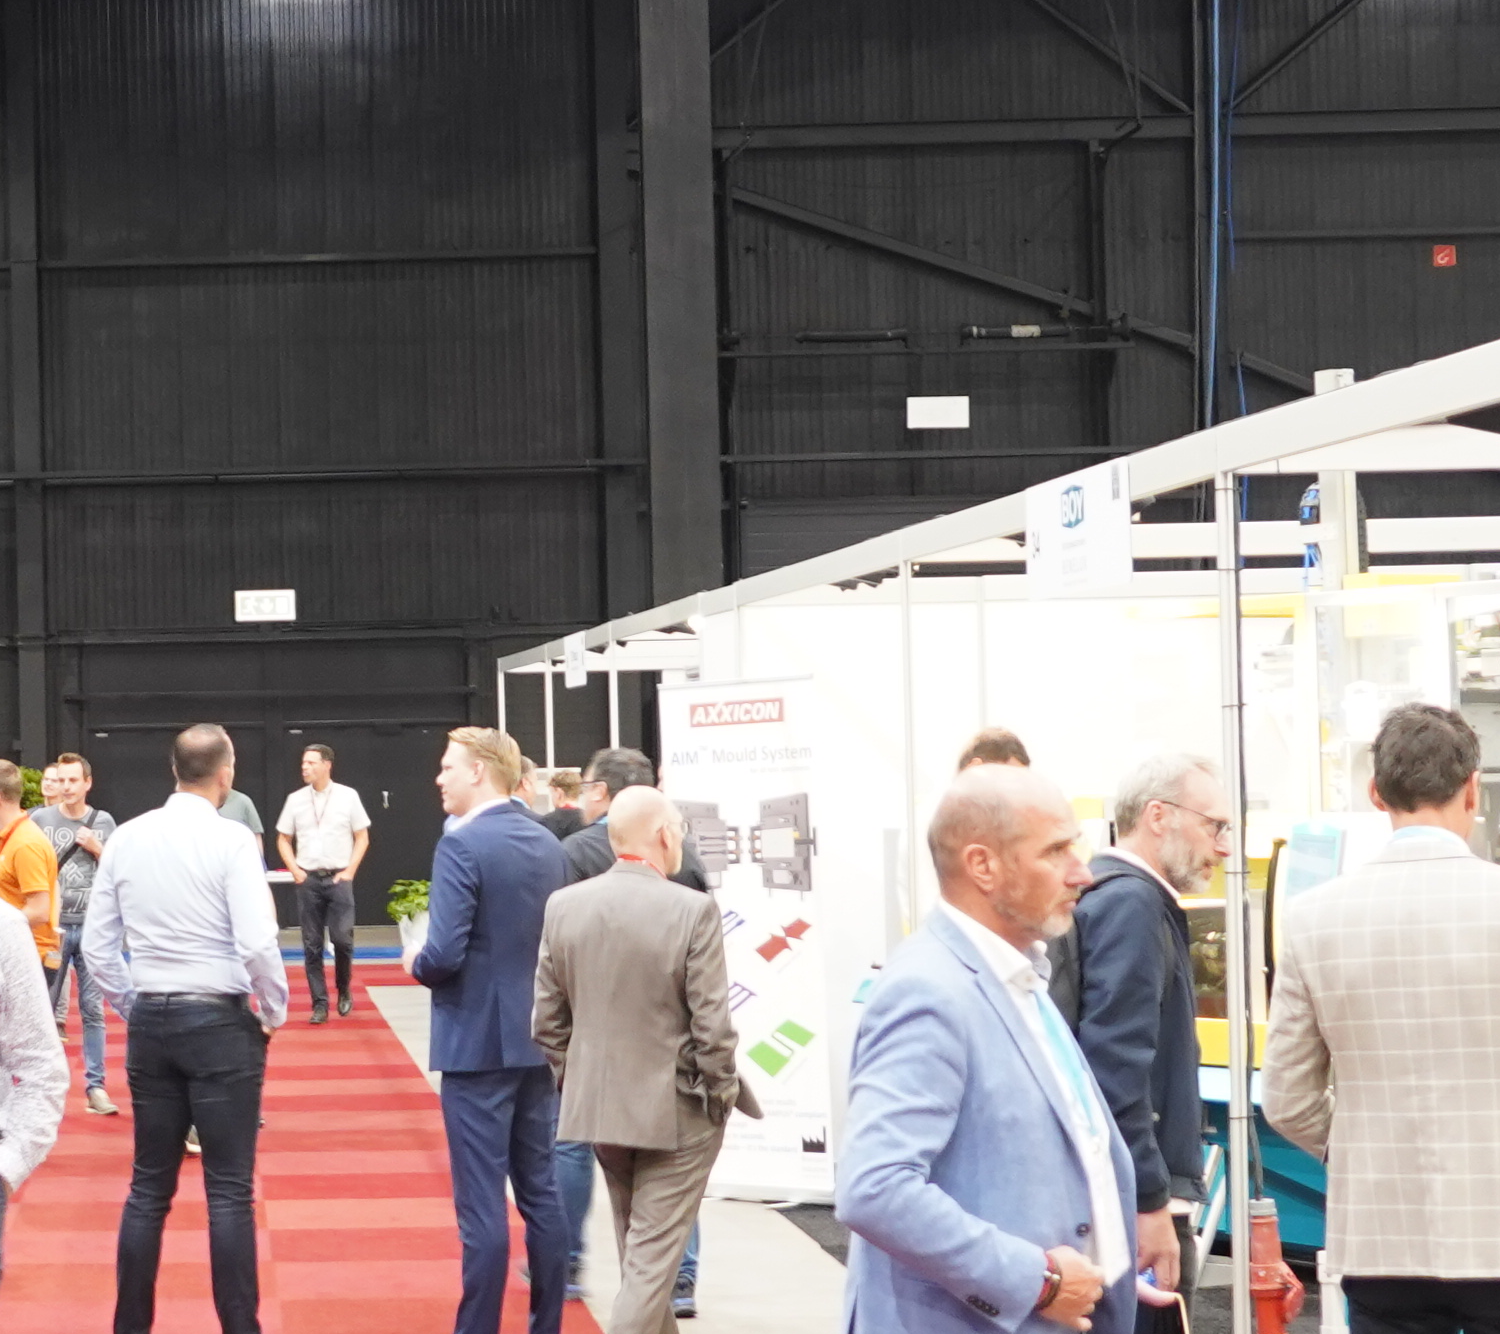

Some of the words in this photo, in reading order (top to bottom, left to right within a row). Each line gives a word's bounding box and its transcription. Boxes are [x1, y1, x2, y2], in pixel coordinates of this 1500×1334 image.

[1062, 490, 1084, 525] BOY
[692, 701, 780, 726] AXXICON
[712, 747, 758, 765] Mould
[761, 744, 813, 764] System
